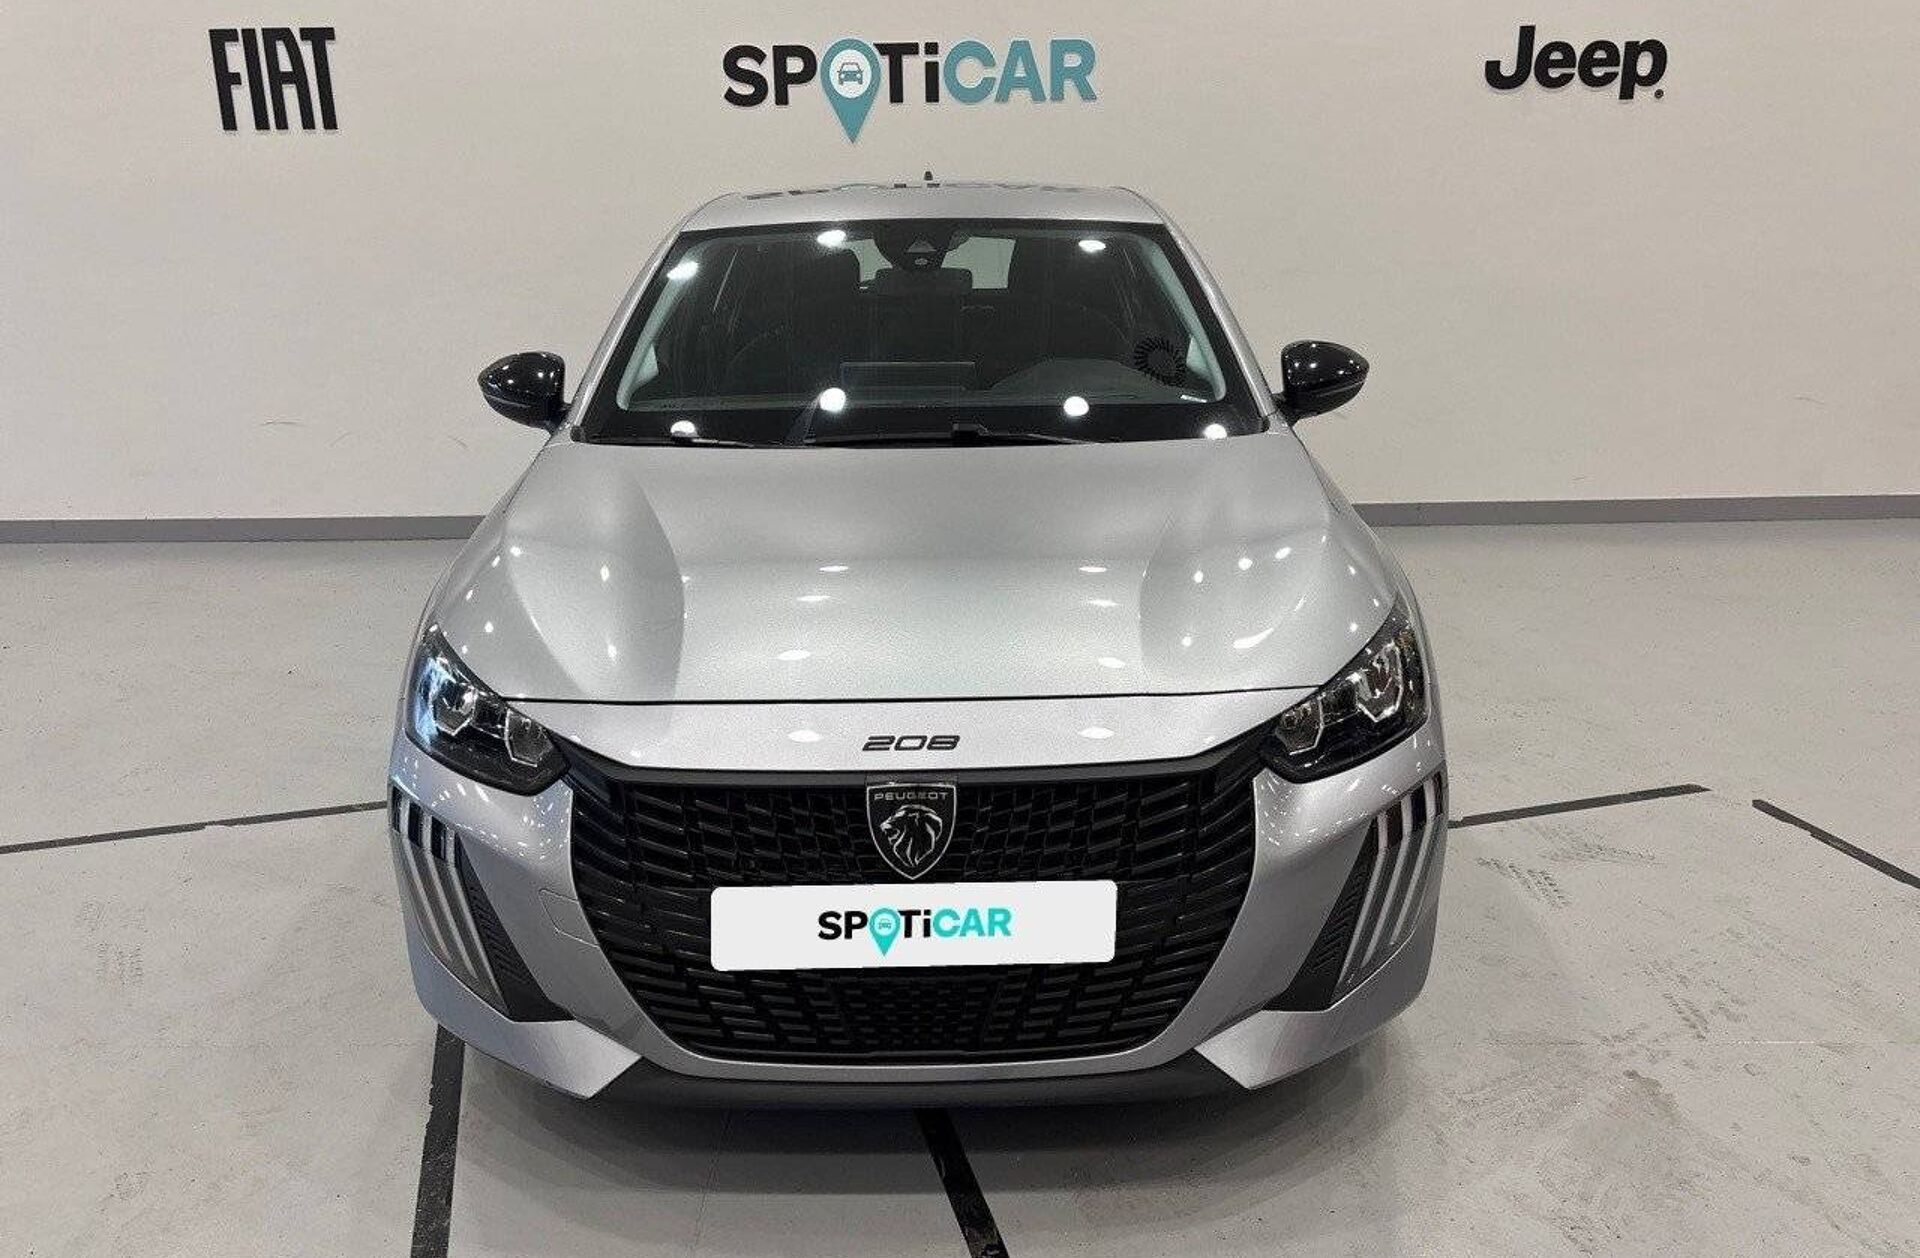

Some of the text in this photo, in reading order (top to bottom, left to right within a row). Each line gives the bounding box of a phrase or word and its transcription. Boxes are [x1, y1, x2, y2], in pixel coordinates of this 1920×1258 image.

[209, 27, 338, 131] FIAT
[1485, 25, 1667, 100] Jeep
[863, 735, 960, 751] 208
[874, 791, 948, 801] PEUGEOT
